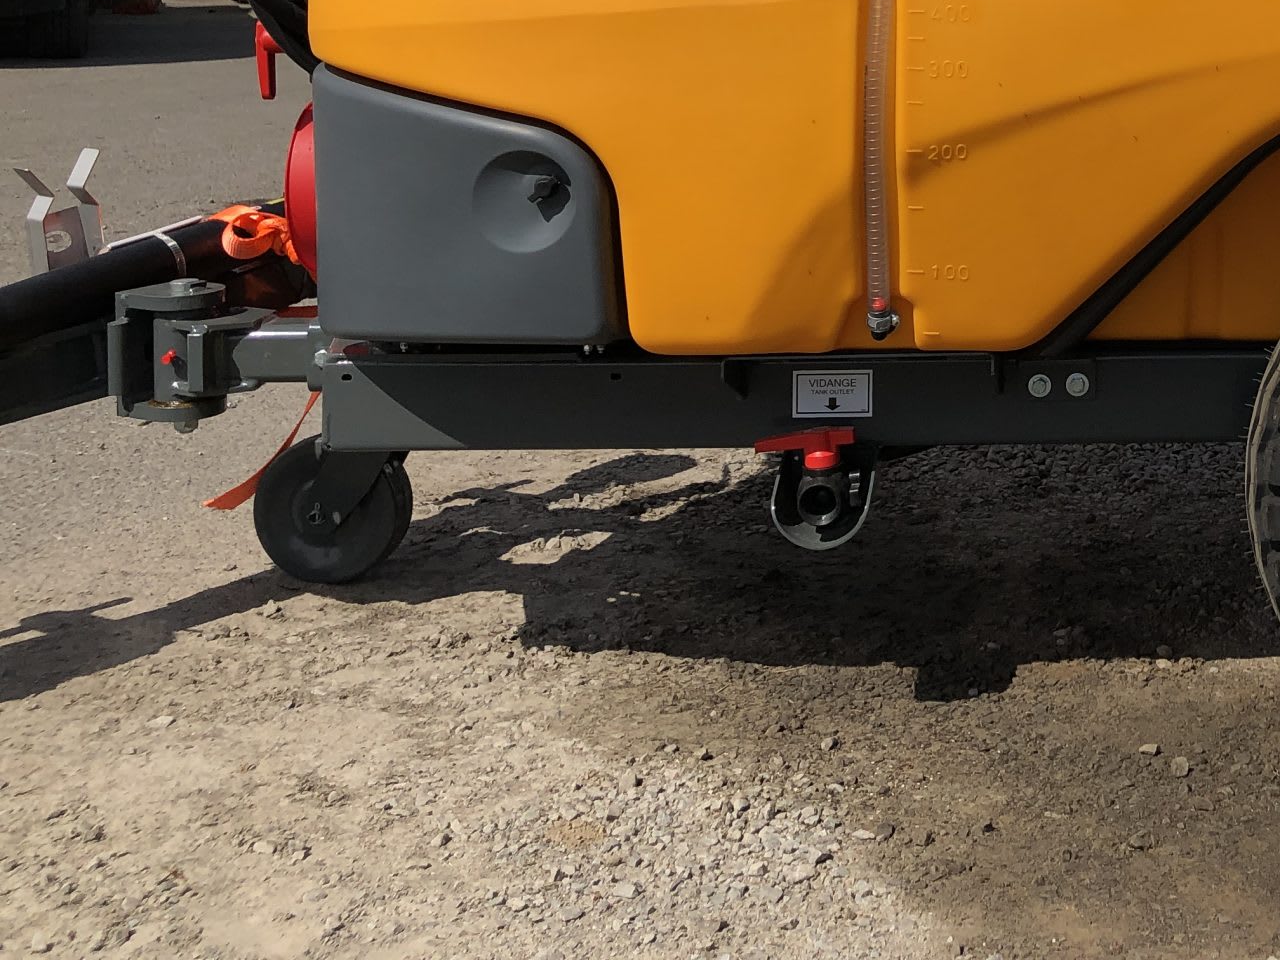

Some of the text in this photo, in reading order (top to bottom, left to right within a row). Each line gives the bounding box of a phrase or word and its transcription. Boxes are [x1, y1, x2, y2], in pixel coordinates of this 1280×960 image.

[931, 4, 971, 23] 400
[928, 59, 969, 79] 300
[927, 143, 967, 161] 200
[931, 263, 969, 281] 100
[808, 378, 857, 388] VIDANGE
